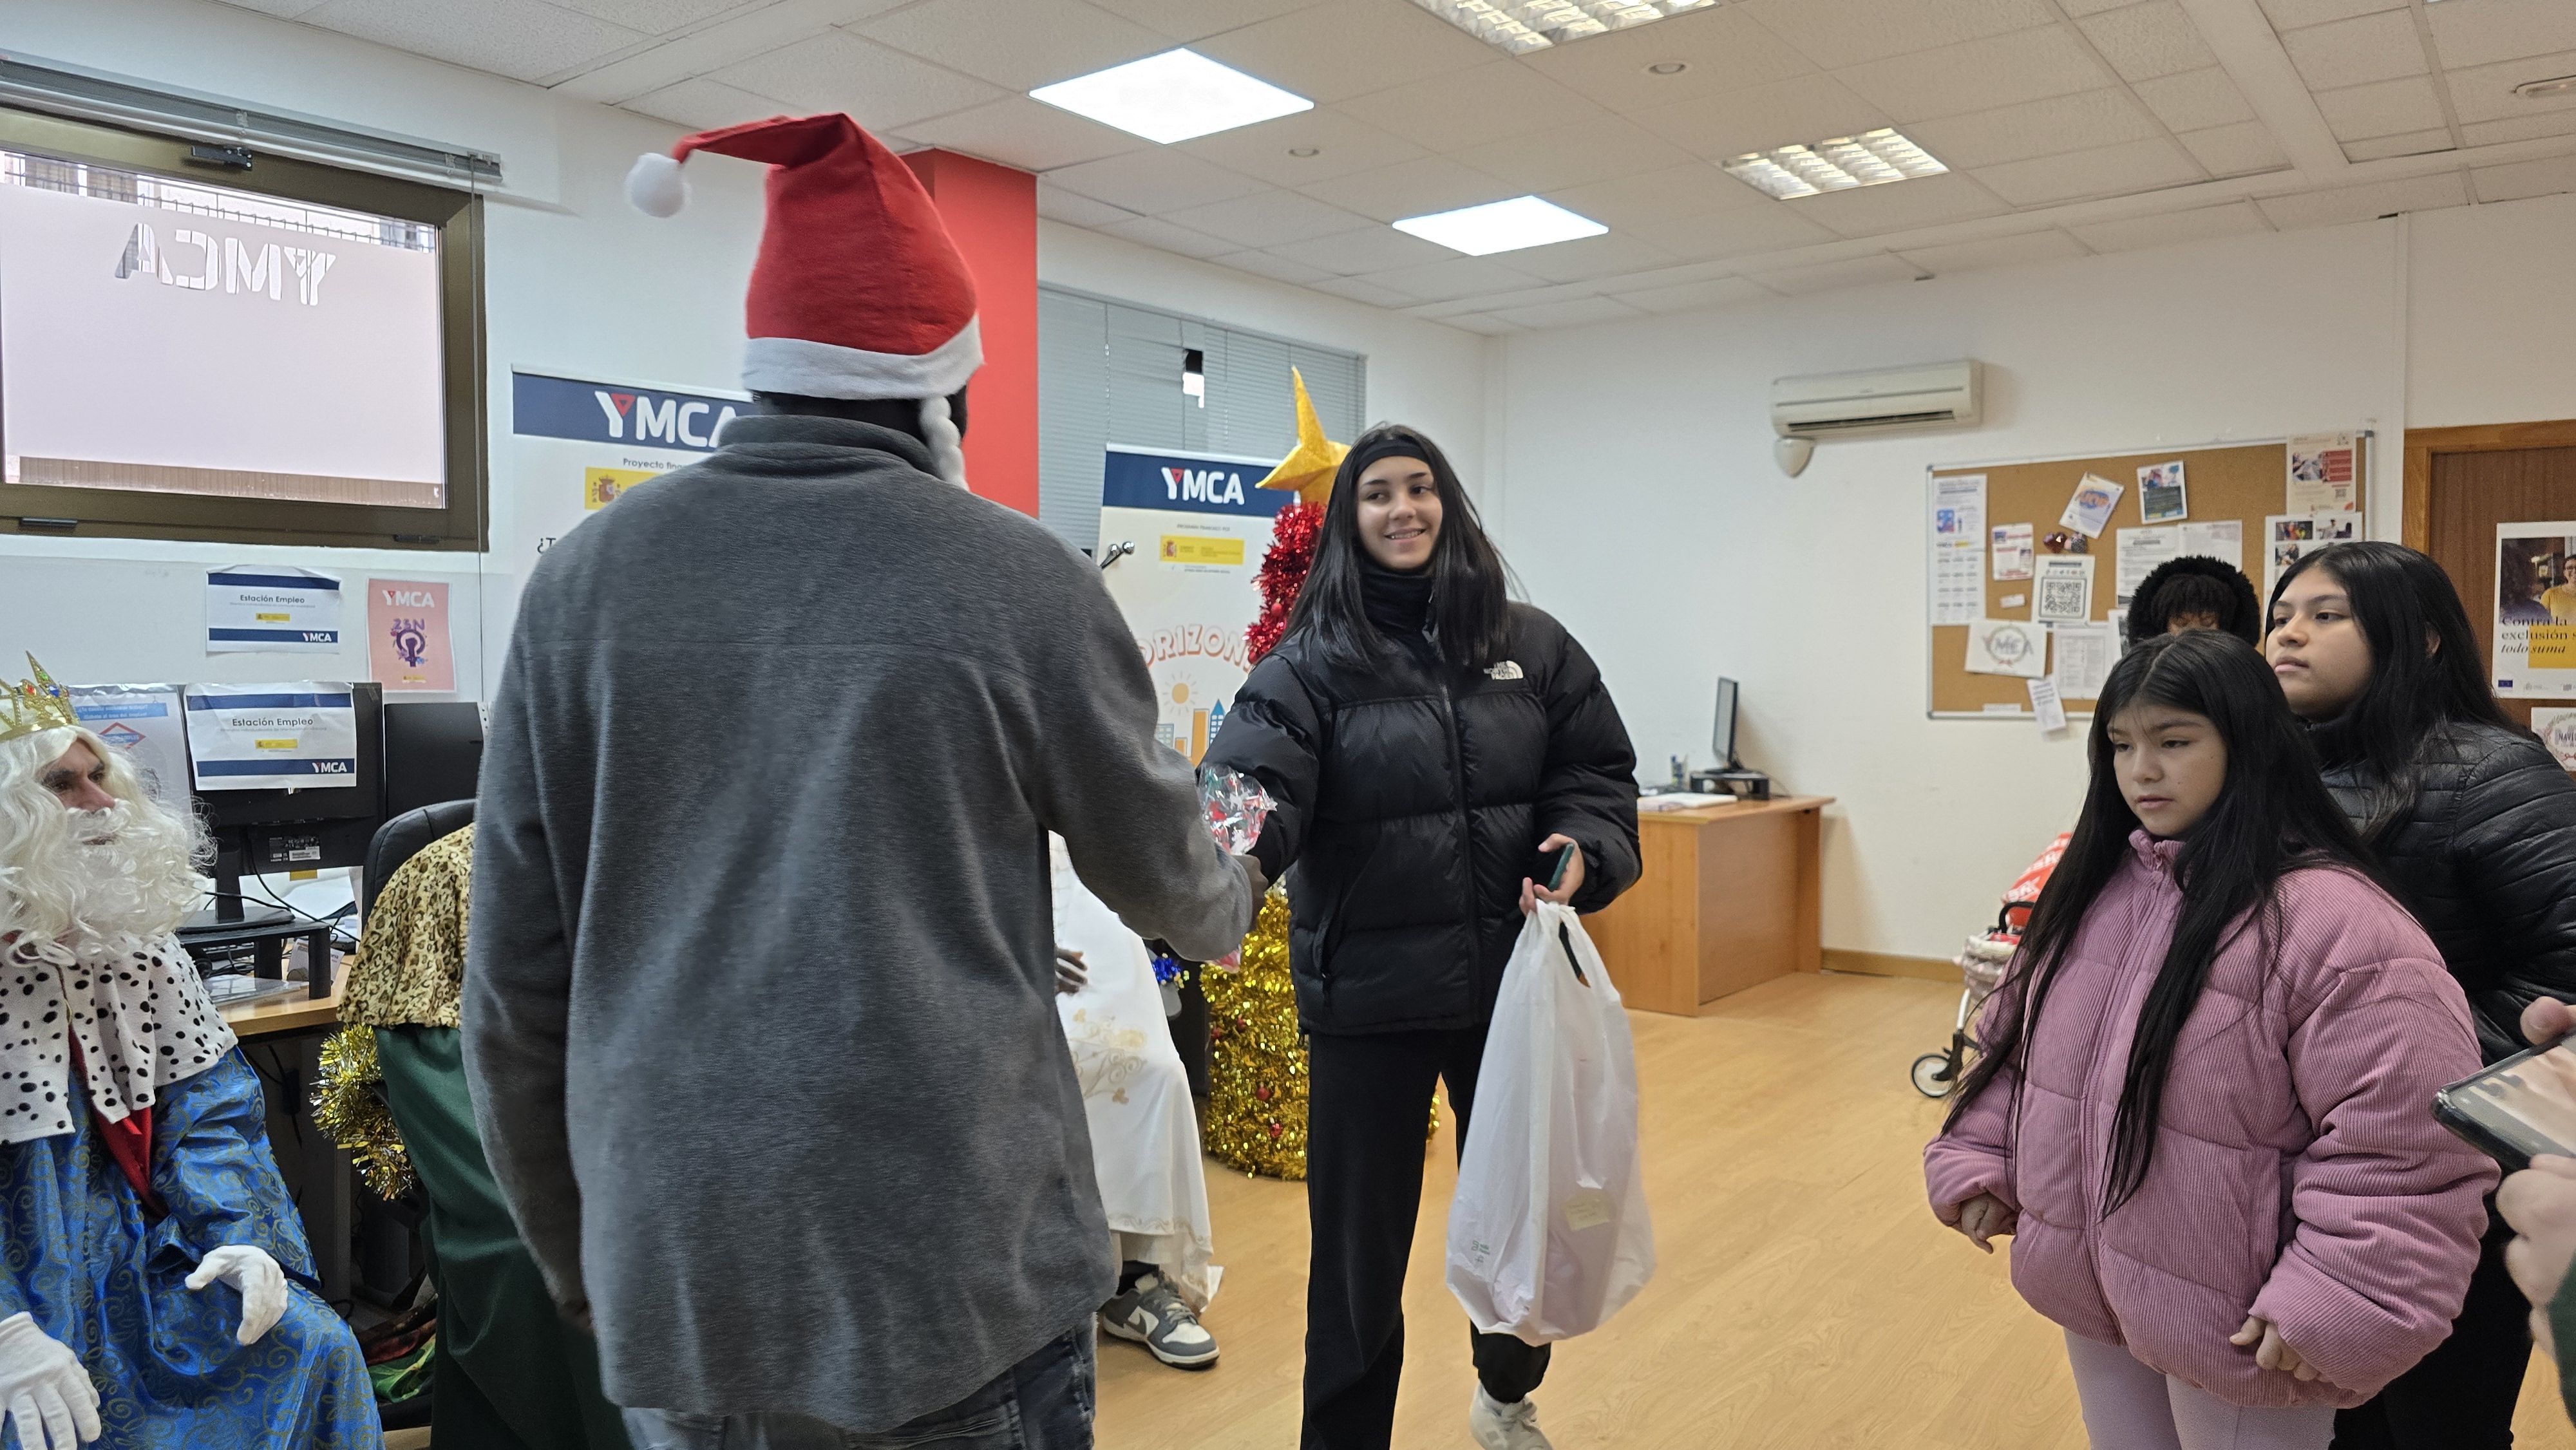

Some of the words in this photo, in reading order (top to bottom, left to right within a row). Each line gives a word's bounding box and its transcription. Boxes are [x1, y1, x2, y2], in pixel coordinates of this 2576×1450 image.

[623, 458, 664, 469] Proyecto
[1160, 467, 1245, 505] YMCA
[240, 594, 273, 602] Estación
[382, 590, 435, 608] YMCA
[2502, 617, 2550, 626] Contra
[2555, 616, 2567, 626] la
[303, 632, 332, 642] YMCA
[2502, 629, 2568, 640] exclusión
[1137, 623, 1254, 674] ORIZON
[2501, 643, 2528, 653] todo
[232, 717, 274, 726] Estación
[277, 718, 314, 728] Empleo
[2559, 732, 2576, 741] NAVI
[312, 762, 347, 773] YMCA
